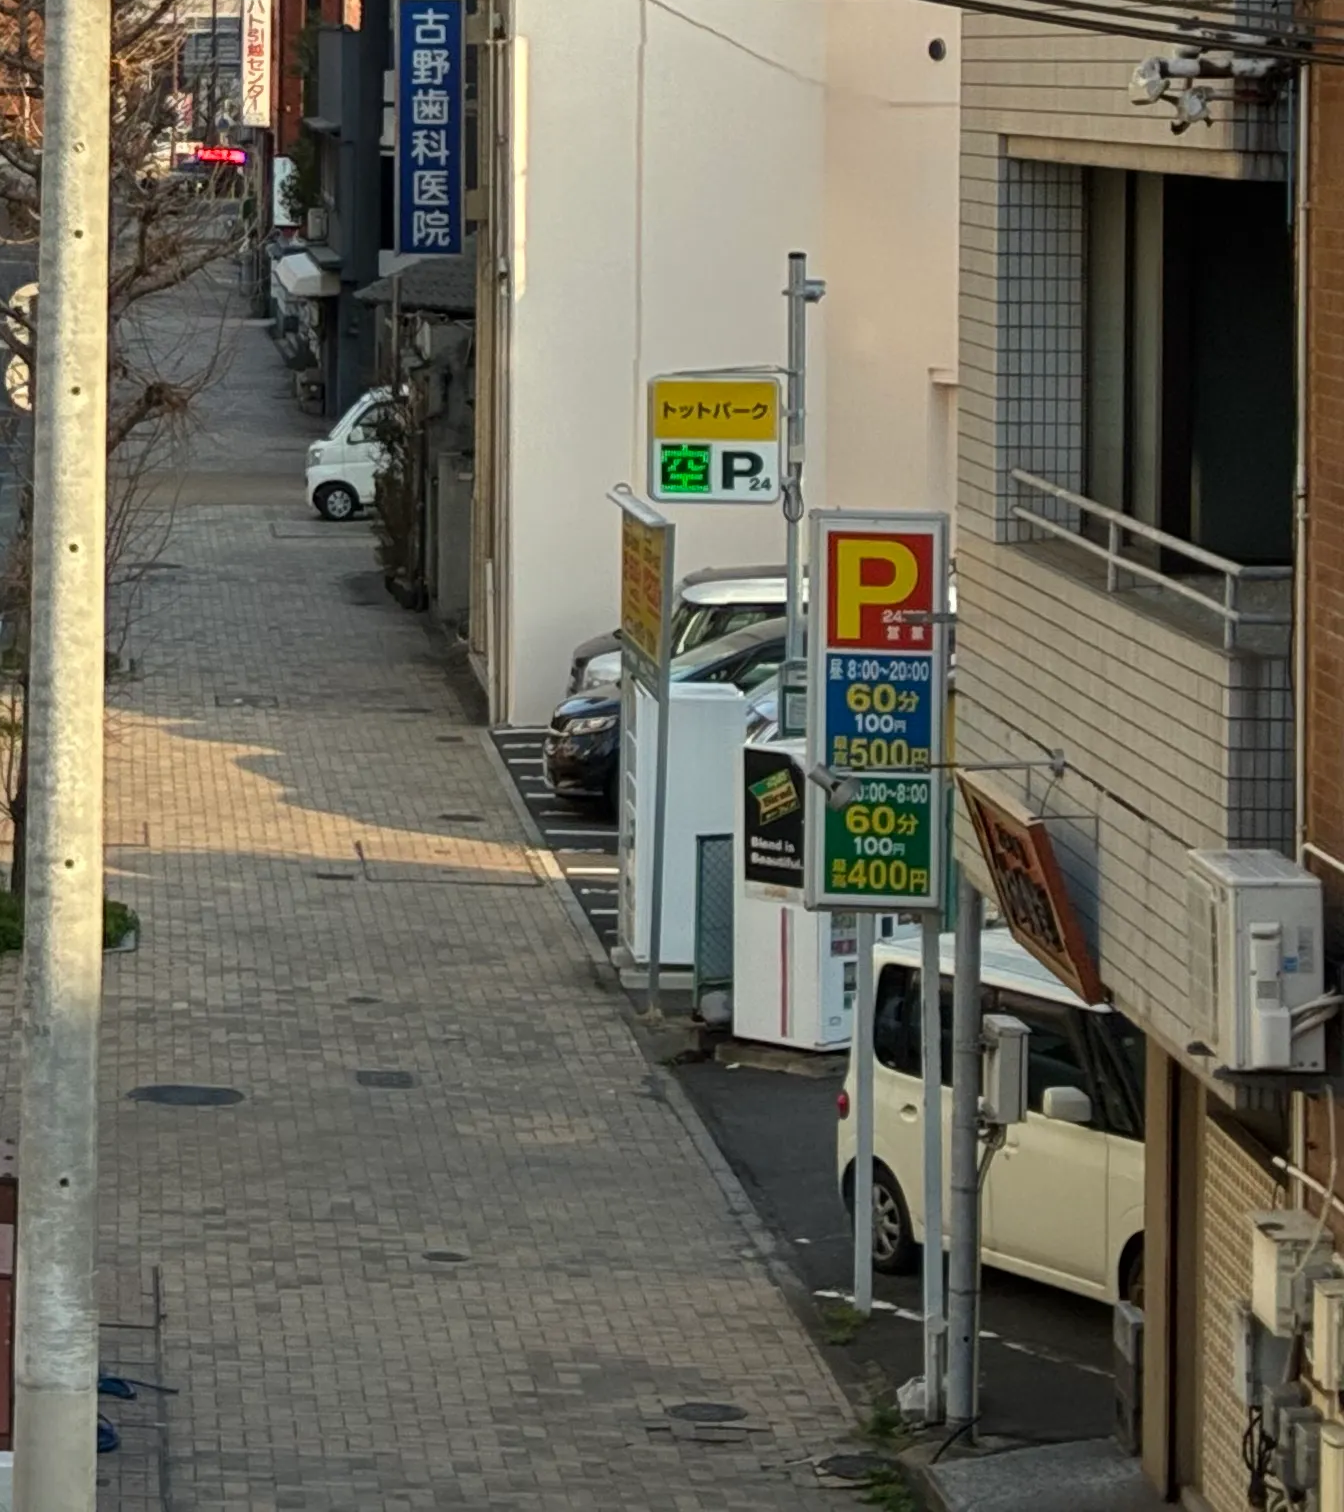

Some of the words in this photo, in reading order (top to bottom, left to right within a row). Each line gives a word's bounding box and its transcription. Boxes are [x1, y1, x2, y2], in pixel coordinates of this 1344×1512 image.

[411, 7, 451, 248] 古野歯科医院
[661, 443, 709, 493] 空
[722, 450, 764, 490] P
[749, 477, 772, 491] 24
[837, 539, 918, 640] P
[847, 683, 920, 713] 60分
[855, 713, 907, 733] 100円
[845, 805, 920, 836] 60分
[750, 836, 783, 851] Blend
[785, 840, 795, 853] is
[853, 836, 906, 857] 100円
[750, 852, 804, 869] Beautiful.
